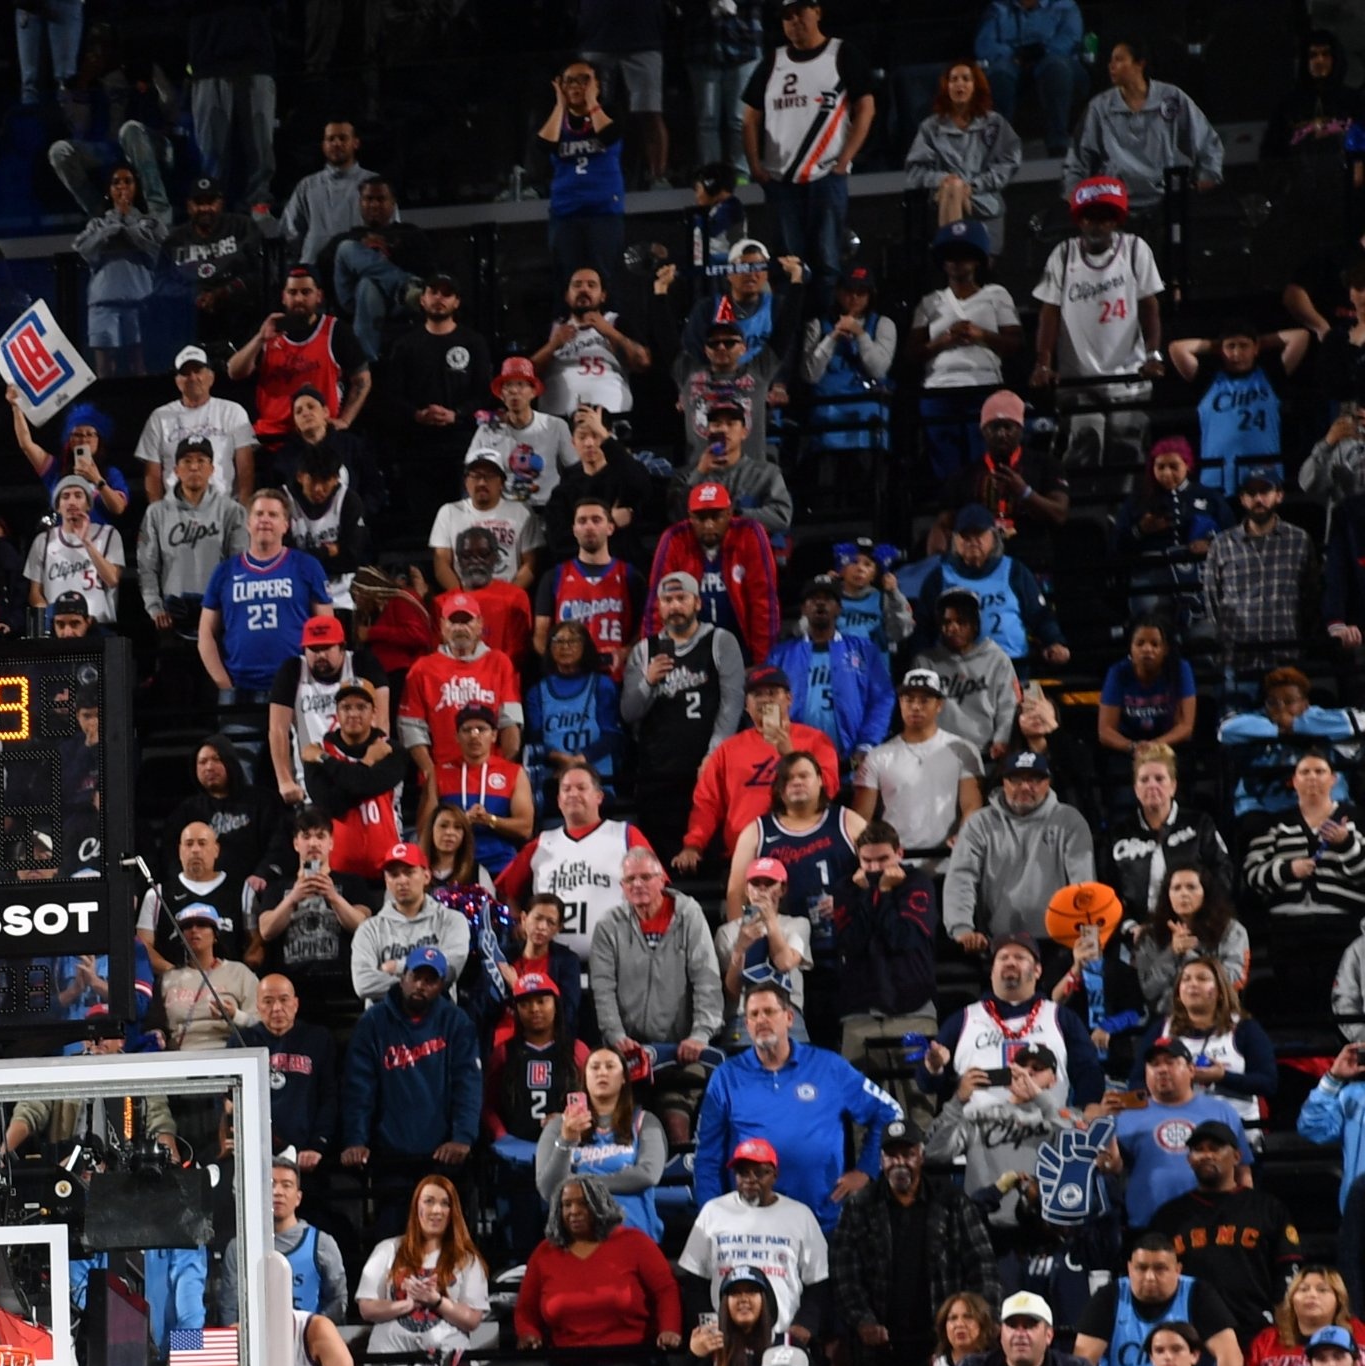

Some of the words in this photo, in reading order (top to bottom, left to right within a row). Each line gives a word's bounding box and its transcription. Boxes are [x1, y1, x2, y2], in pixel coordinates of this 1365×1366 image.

[782, 73, 797, 95] 2
[575, 157, 589, 175] 2
[1098, 299, 1127, 322] 24
[577, 356, 604, 376] 55
[1237, 410, 1266, 432] 24
[168, 519, 219, 547] Clips
[48, 554, 92, 579] Clippe
[232, 578, 292, 602] CLIPPERS
[247, 604, 278, 631] 23
[559, 597, 625, 622] Clippers
[597, 618, 624, 643] 12
[990, 613, 1002, 634] 2
[685, 690, 702, 719] 2
[356, 801, 381, 826] 10
[769, 837, 833, 863] Clippers
[383, 1036, 449, 1072] Clippers
[530, 1090, 548, 1120] 2
[984, 1120, 1051, 1149] Clips
[730, 1250, 750, 1262] THE
[751, 1250, 770, 1262] NET
